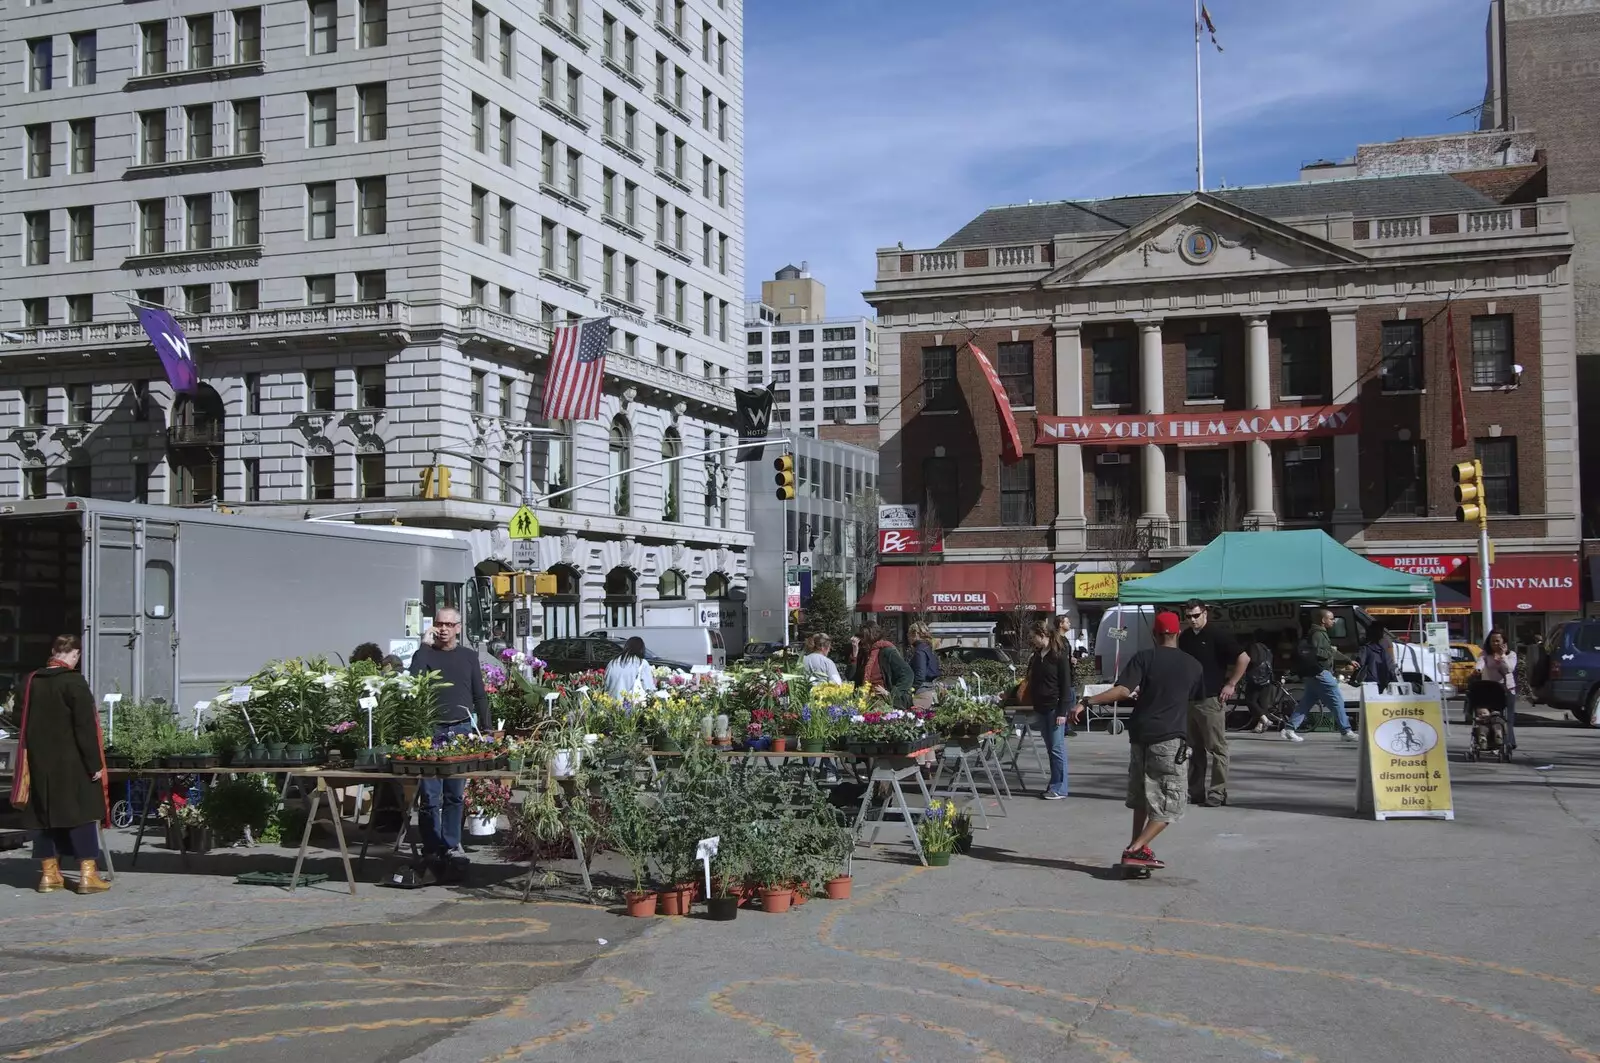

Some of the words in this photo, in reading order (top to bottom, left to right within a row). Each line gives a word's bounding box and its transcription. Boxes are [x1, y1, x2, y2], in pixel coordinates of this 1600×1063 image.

[134, 268, 145, 278] W
[148, 267, 167, 277] NEW
[225, 259, 260, 270] SQUARE
[161, 332, 191, 361] W
[747, 406, 769, 427] W
[1043, 422, 1094, 438] NEW
[1100, 421, 1163, 439] YORK
[1169, 419, 1228, 437] FILM
[1233, 411, 1352, 434] ACADEMY
[1394, 557, 1417, 566] DIET
[1419, 557, 1440, 566] LITE
[1391, 566, 1446, 575] E-CREAM
[1528, 576, 1573, 589] NAILS
[932, 593, 961, 604] TREVI
[964, 593, 986, 604] DELI
[1382, 708, 1425, 718] Cyclists
[1390, 758, 1427, 767] Please
[1380, 771, 1429, 780] dismount
[1433, 770, 1441, 779] &
[1386, 784, 1411, 793] walk
[1414, 785, 1438, 794] your
[1401, 796, 1425, 806] bike
